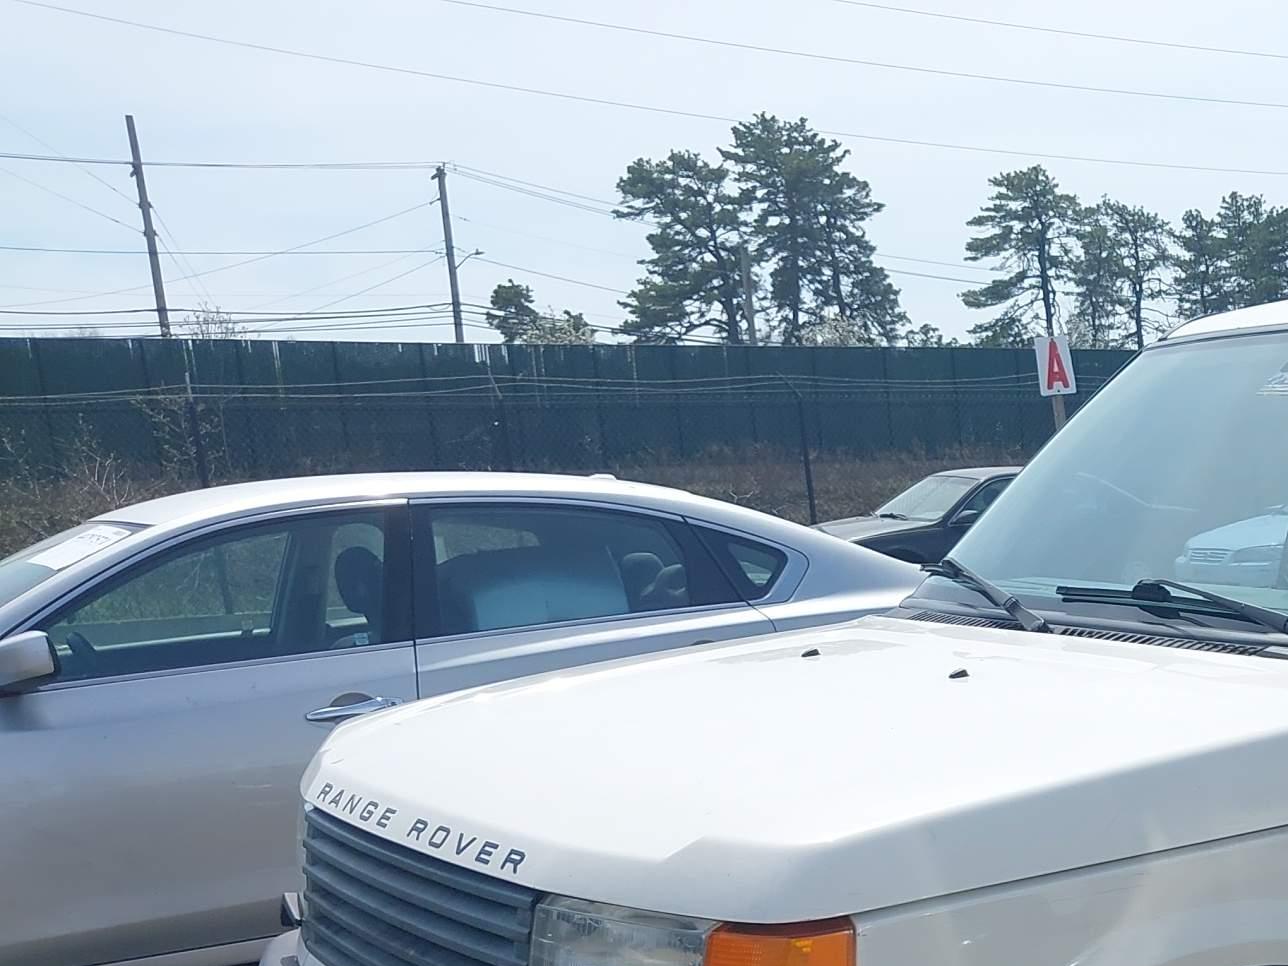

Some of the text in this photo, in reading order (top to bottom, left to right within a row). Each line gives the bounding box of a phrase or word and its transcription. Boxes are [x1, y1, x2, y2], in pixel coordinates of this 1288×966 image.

[1047, 338, 1070, 390] A
[316, 782, 526, 874] RANGE ROVER
